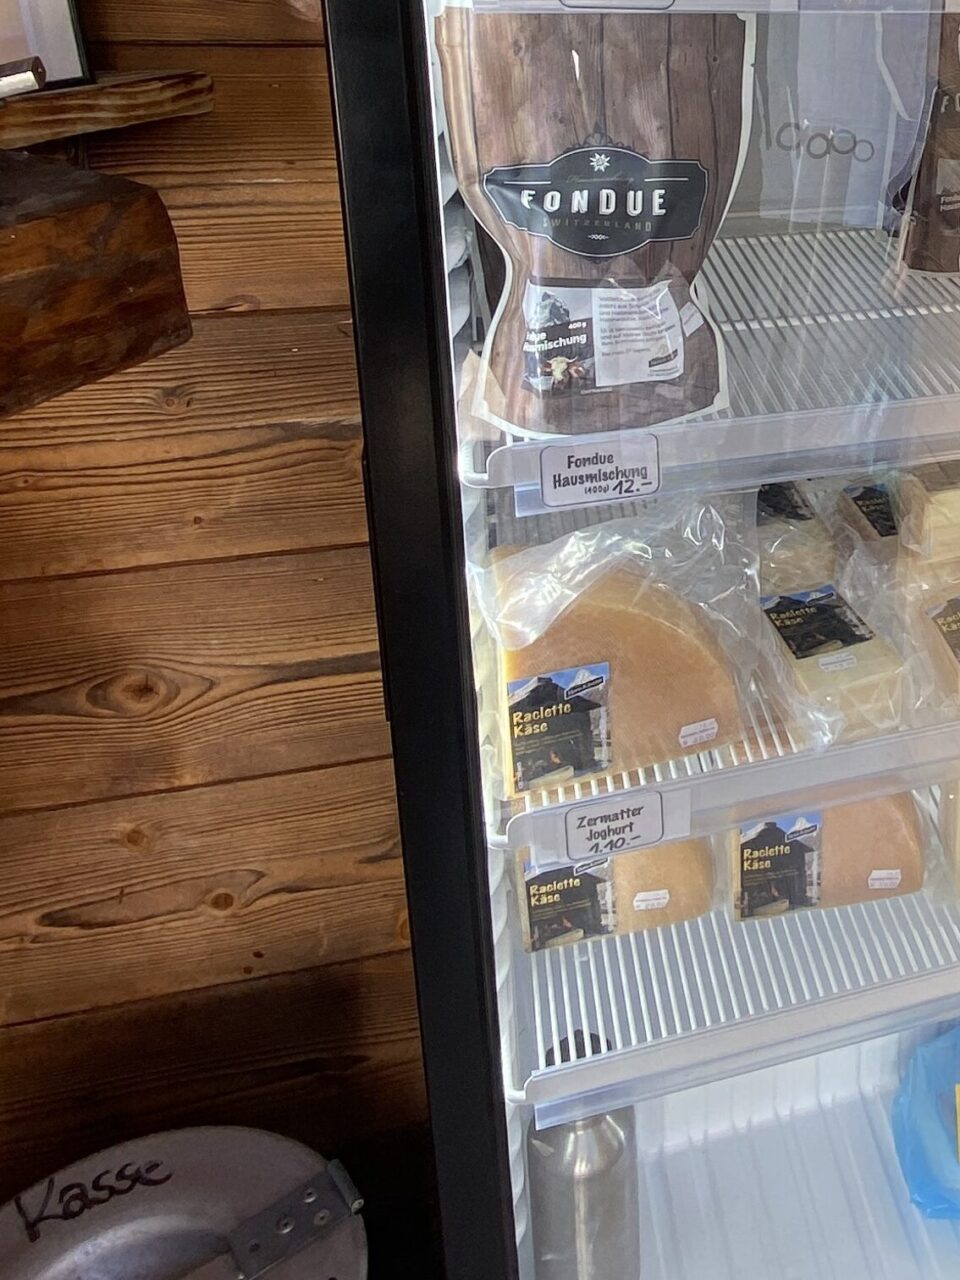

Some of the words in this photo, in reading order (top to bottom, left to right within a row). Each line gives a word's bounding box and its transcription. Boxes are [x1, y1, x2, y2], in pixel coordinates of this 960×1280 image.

[519, 187, 668, 217] FONDUE
[566, 452, 615, 469] Fondue
[551, 465, 649, 490] Hausmischung
[512, 702, 572, 725] Raclette
[513, 721, 549, 739] Käse
[576, 804, 644, 830] Zermatter
[585, 822, 635, 842] Joghurt
[743, 844, 792, 860] Raclette
[743, 858, 772, 872] Käse
[529, 877, 581, 895] Raclette
[530, 892, 561, 908] Käse
[14, 1158, 173, 1243] Kasse
